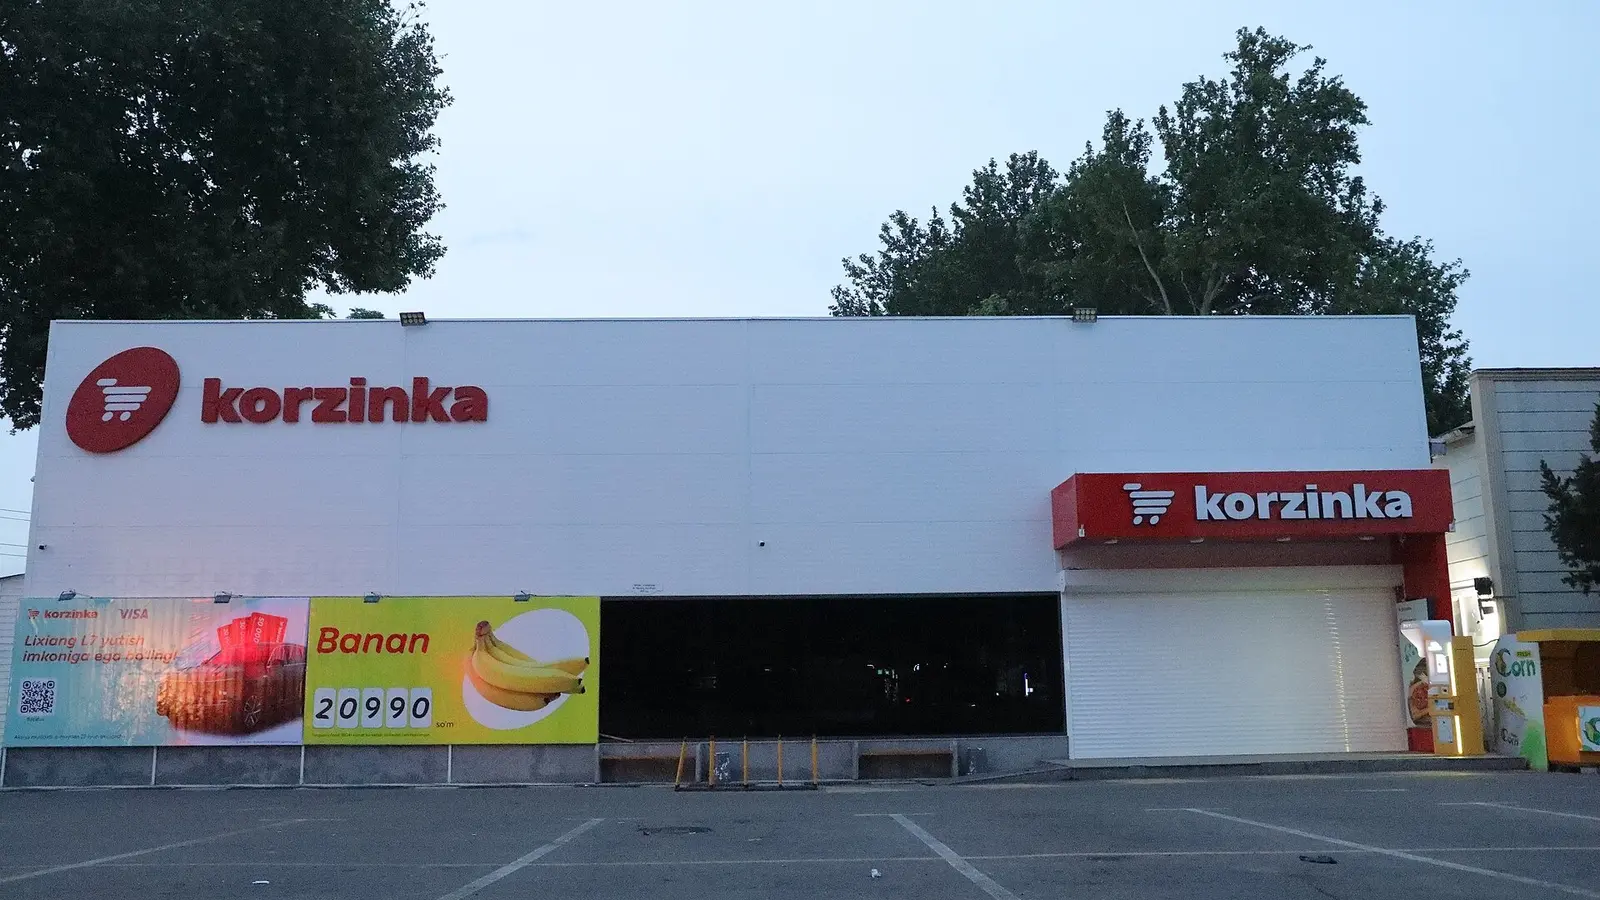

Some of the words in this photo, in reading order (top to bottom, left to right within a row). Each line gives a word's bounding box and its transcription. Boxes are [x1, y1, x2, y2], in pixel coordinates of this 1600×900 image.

[201, 376, 489, 423] korzinka
[1195, 483, 1413, 521] korzinka
[44, 609, 98, 619] korzinka
[120, 609, 149, 619] VISA
[24, 635, 77, 648] Lixiang
[81, 635, 97, 647] L7
[101, 634, 145, 648] yutish
[316, 627, 430, 654] Banan
[22, 650, 91, 664] imkoniga
[95, 653, 121, 664] ega
[1495, 648, 1536, 677] Corn
